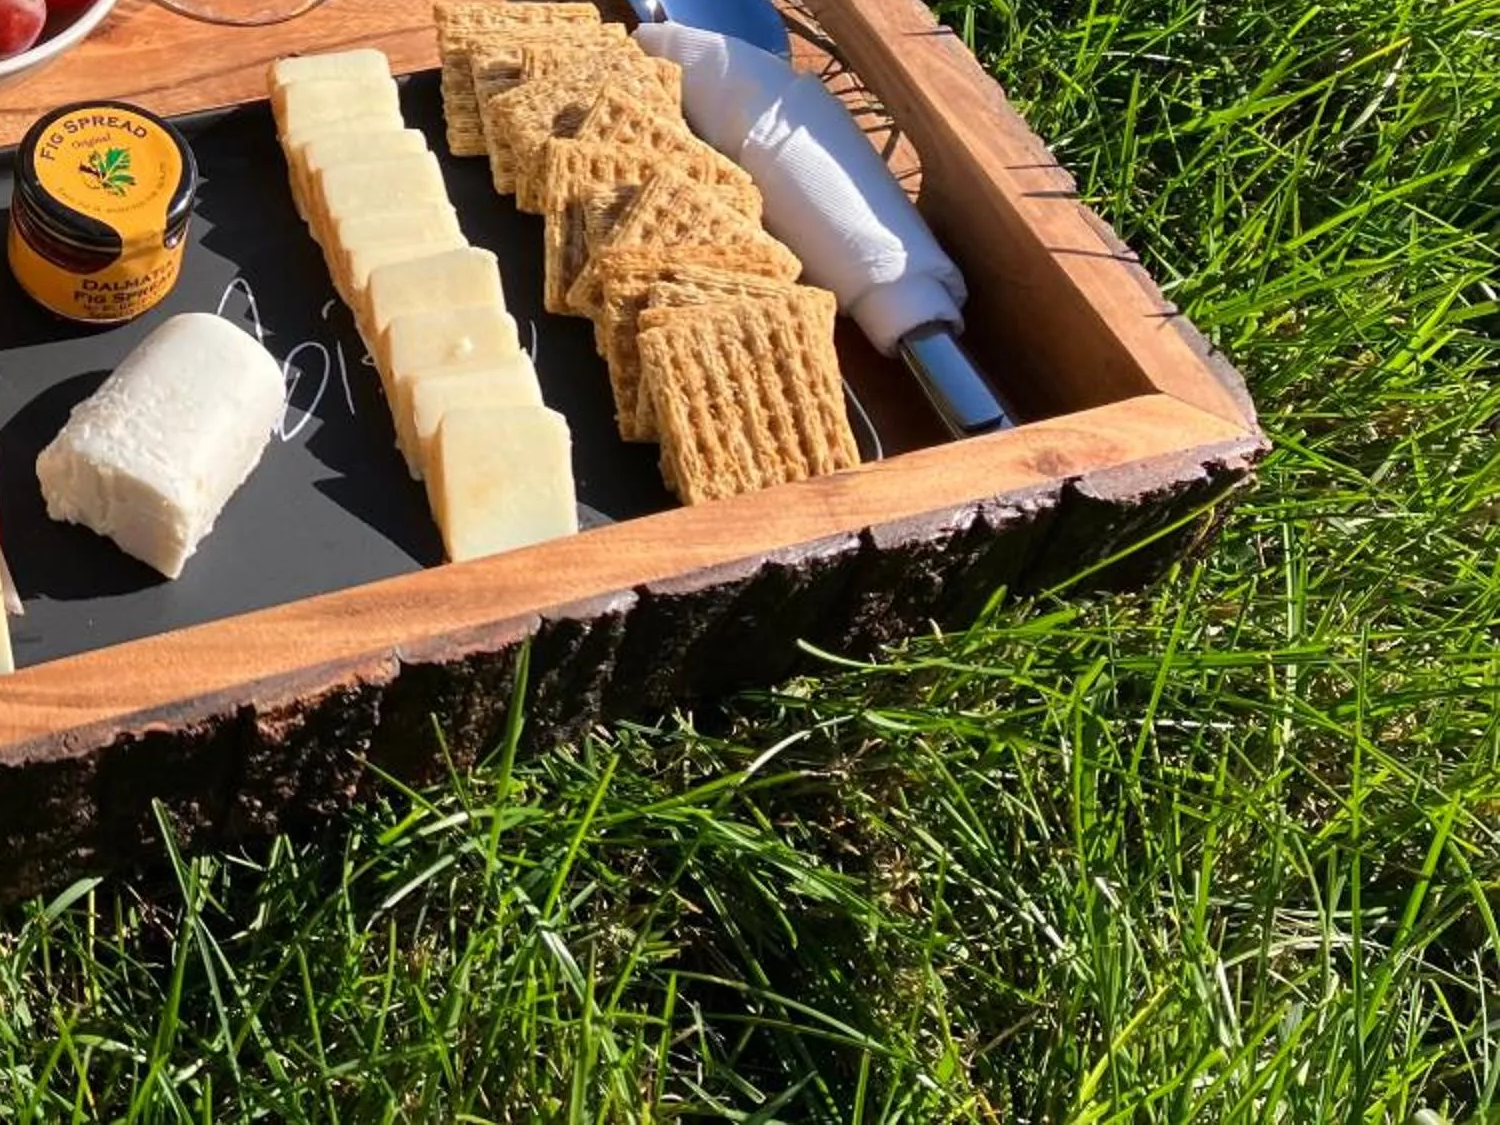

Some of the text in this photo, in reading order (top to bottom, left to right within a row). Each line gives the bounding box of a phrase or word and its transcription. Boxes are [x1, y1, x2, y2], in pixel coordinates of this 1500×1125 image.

[40, 115, 148, 162] FIG SPREAD
[71, 132, 112, 148] Original
[73, 289, 107, 305] FIG
